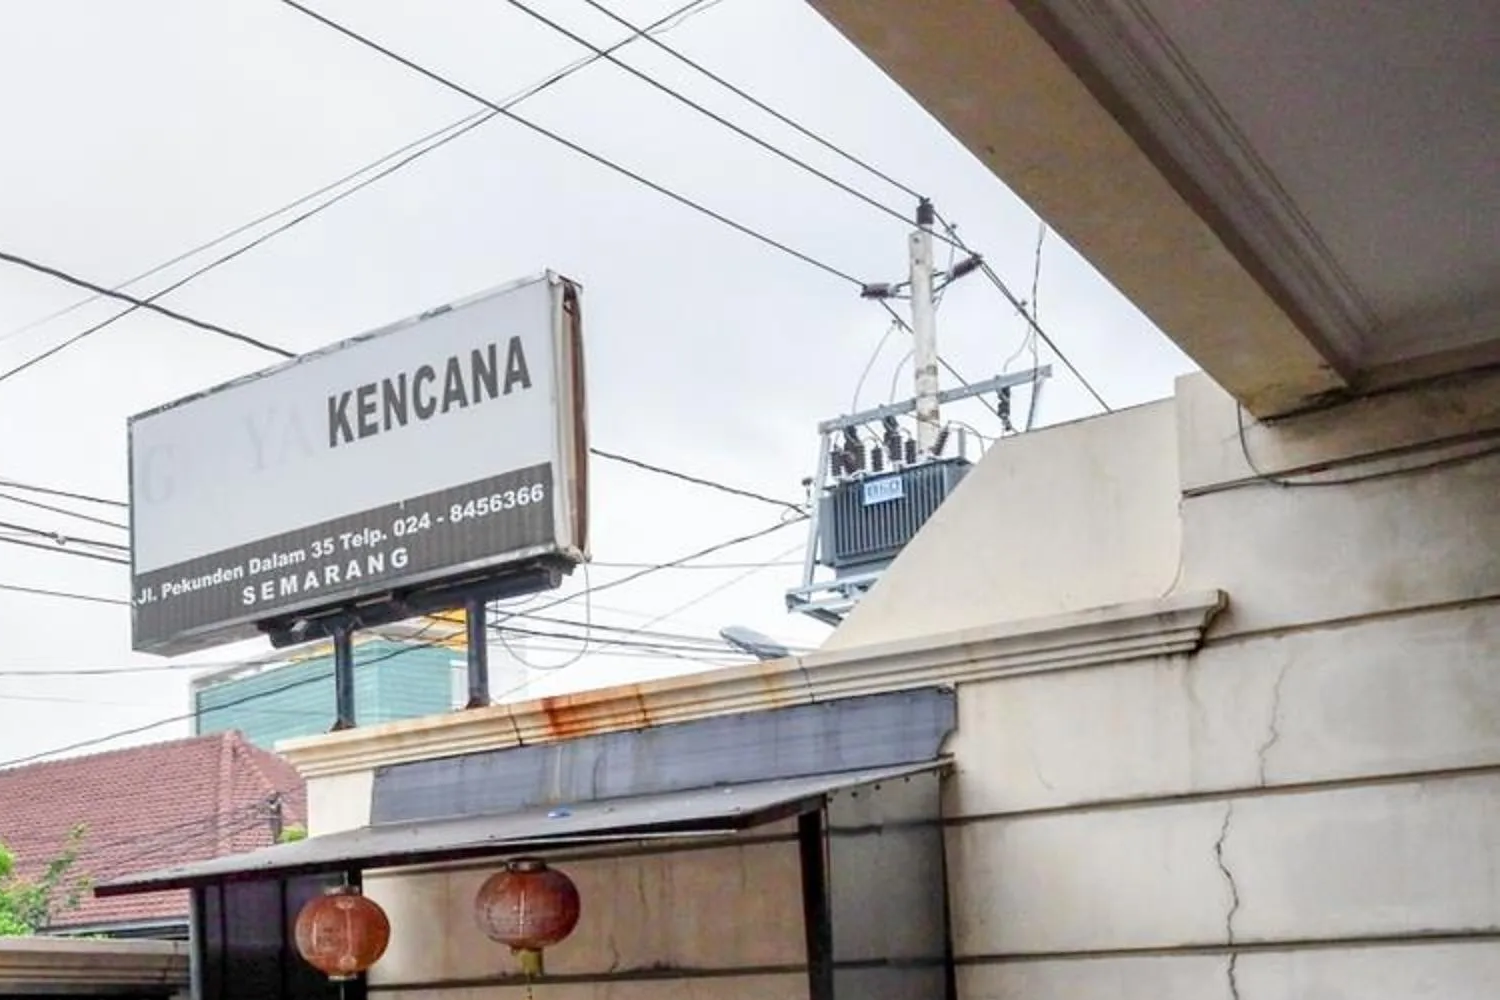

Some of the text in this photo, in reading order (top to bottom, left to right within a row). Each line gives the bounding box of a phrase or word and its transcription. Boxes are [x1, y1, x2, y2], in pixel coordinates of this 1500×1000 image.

[327, 335, 532, 448] KENCANA
[161, 564, 244, 599] Pekunden
[249, 548, 306, 575] Dalam
[311, 537, 335, 559] 35
[340, 527, 388, 550] Telp.
[393, 511, 431, 537] 024
[449, 483, 544, 523] 8456366
[243, 547, 409, 605] SEMARANG
